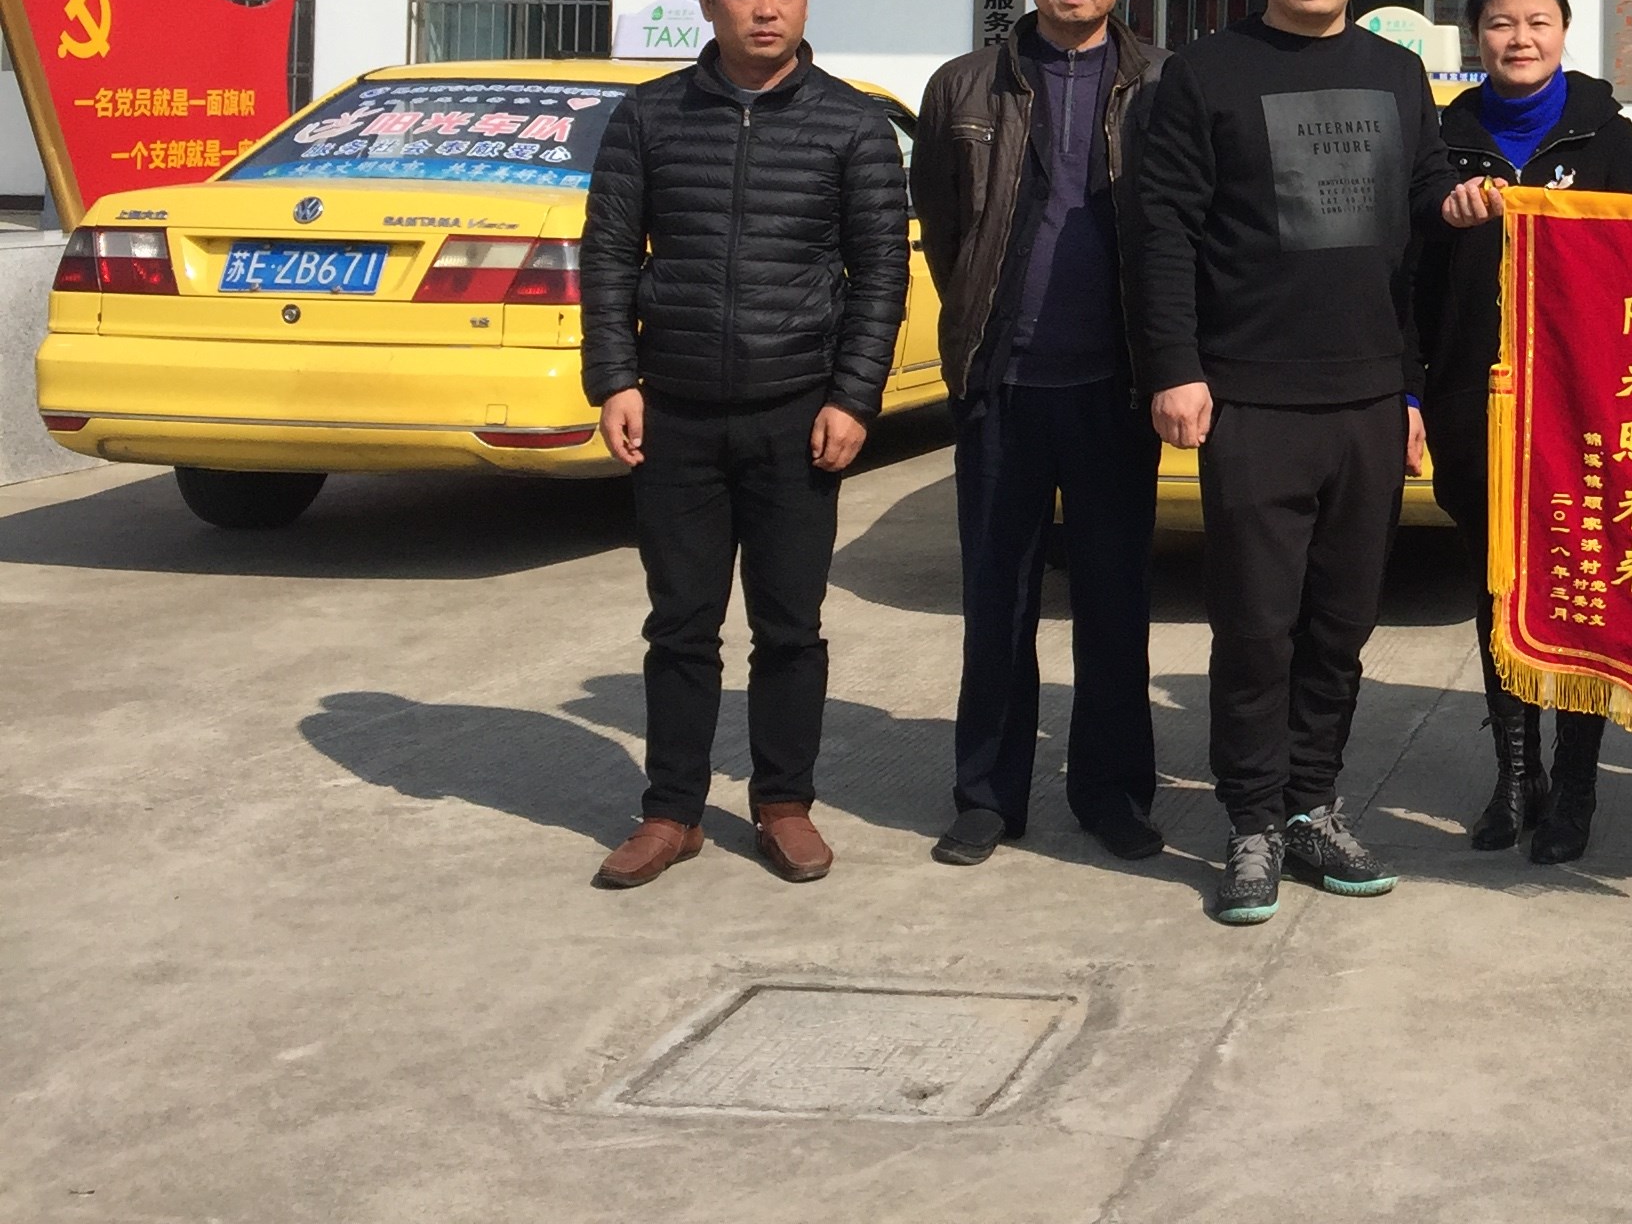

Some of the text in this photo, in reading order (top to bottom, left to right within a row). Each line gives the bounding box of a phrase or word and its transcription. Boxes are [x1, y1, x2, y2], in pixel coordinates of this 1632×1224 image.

[643, 26, 700, 48] TAXI
[74, 88, 256, 118] 一名党员就是一面旗帜
[361, 110, 576, 143] 阳光车队
[1297, 120, 1382, 137] ALTERNATE
[1312, 139, 1372, 156] FUTURE
